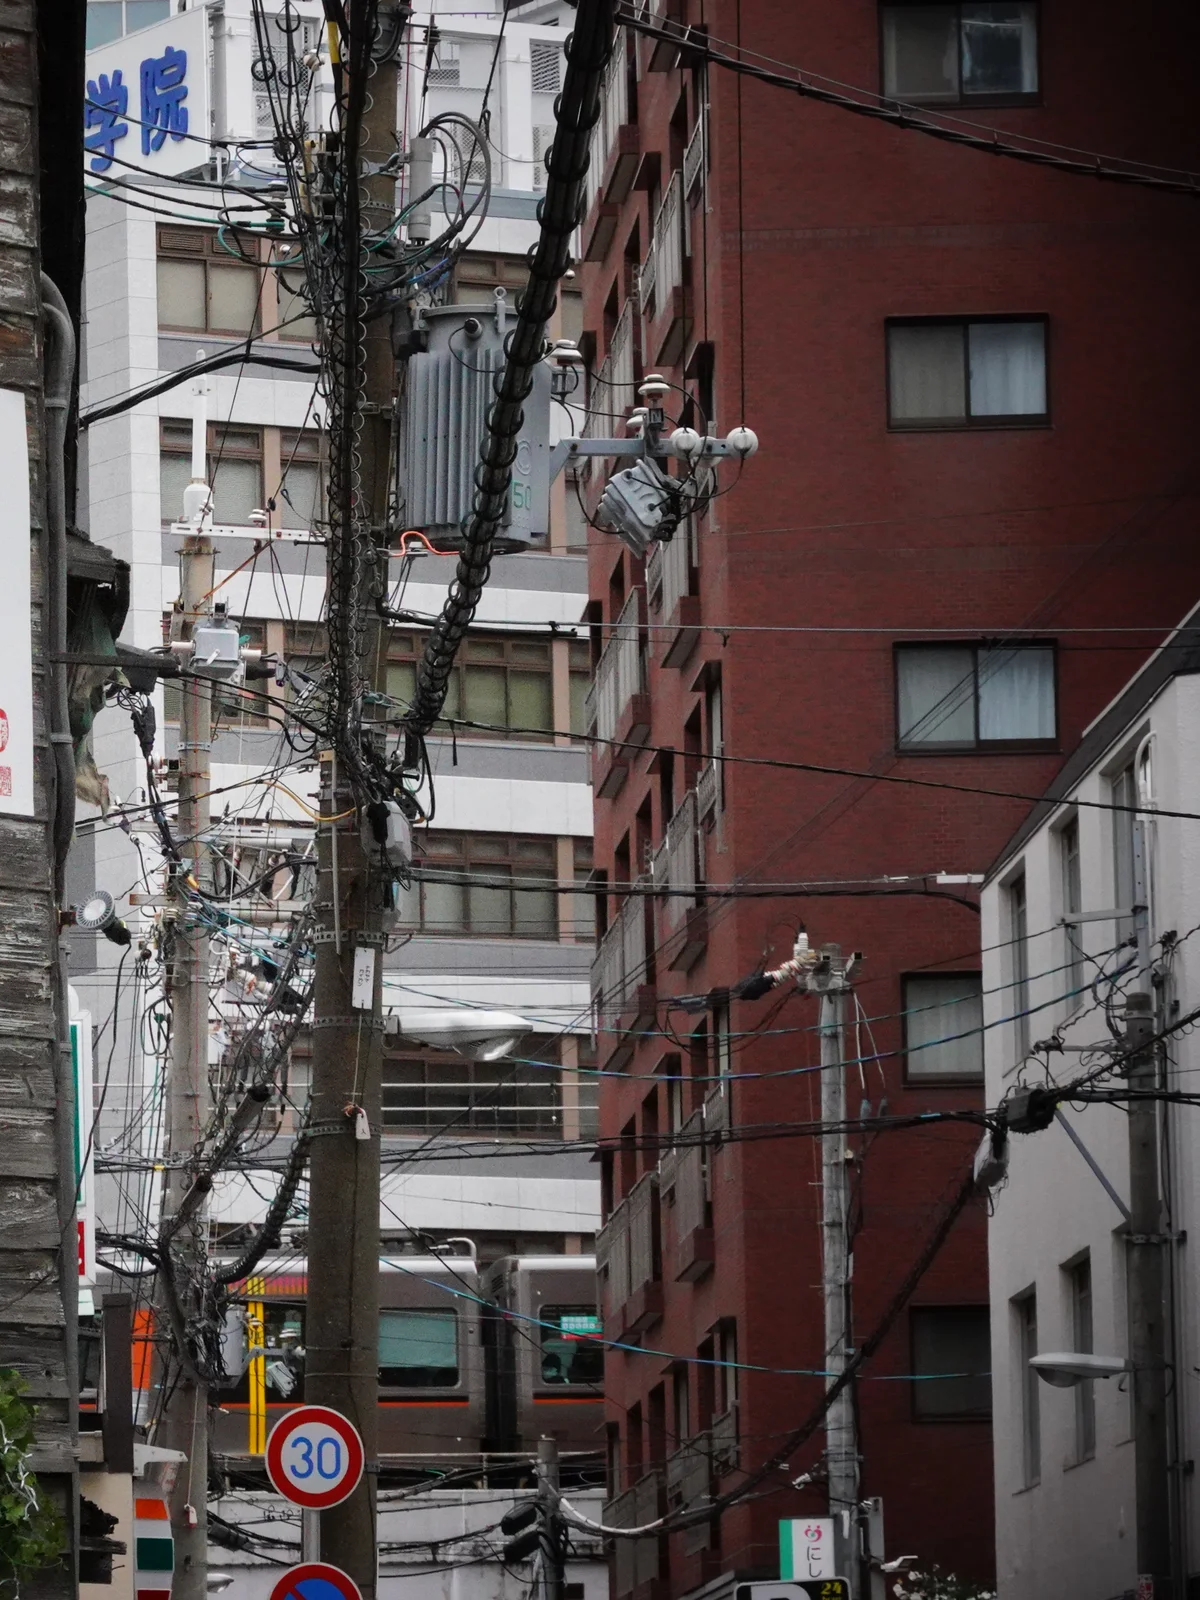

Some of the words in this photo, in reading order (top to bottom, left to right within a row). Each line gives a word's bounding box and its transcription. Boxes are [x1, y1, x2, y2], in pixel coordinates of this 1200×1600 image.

[84, 46, 188, 172] 学院
[511, 481, 531, 511] 50
[290, 1437, 341, 1479] 30
[807, 1546, 822, 1578] にし
[820, 1582, 842, 1595] 24
